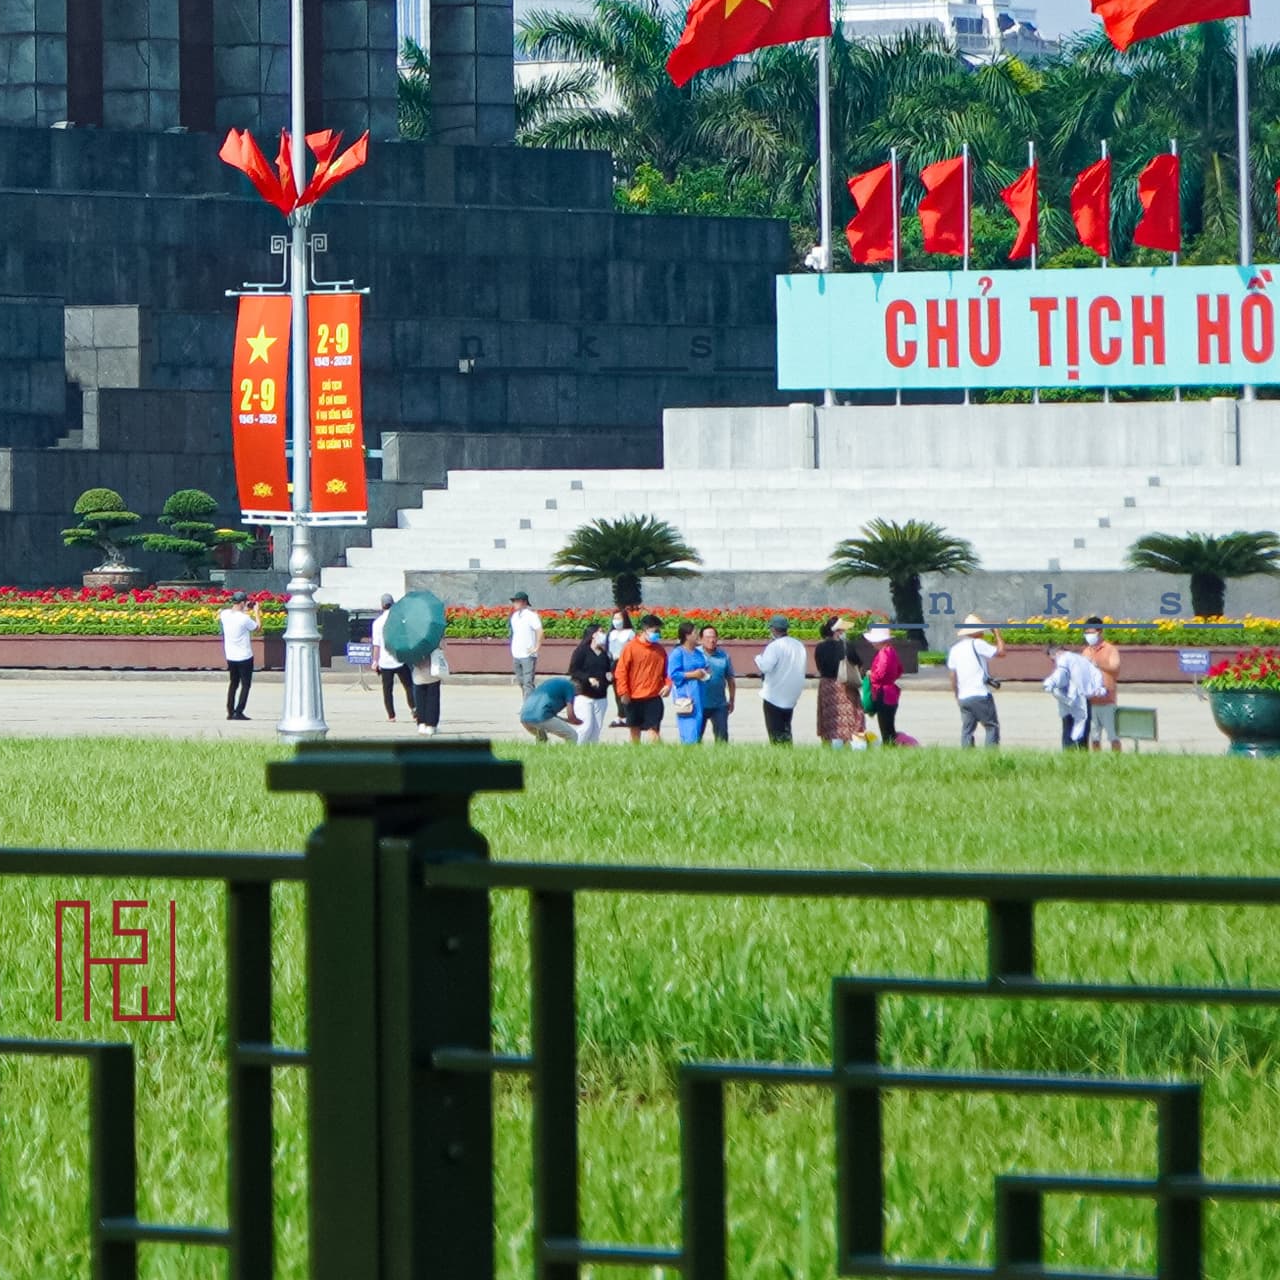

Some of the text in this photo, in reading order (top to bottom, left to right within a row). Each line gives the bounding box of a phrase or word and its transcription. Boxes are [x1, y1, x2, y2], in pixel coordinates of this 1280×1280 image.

[317, 323, 350, 355] 2-9
[885, 269, 1275, 380] CHỦ TỊCH HỒ
[240, 378, 276, 411] 2-9
